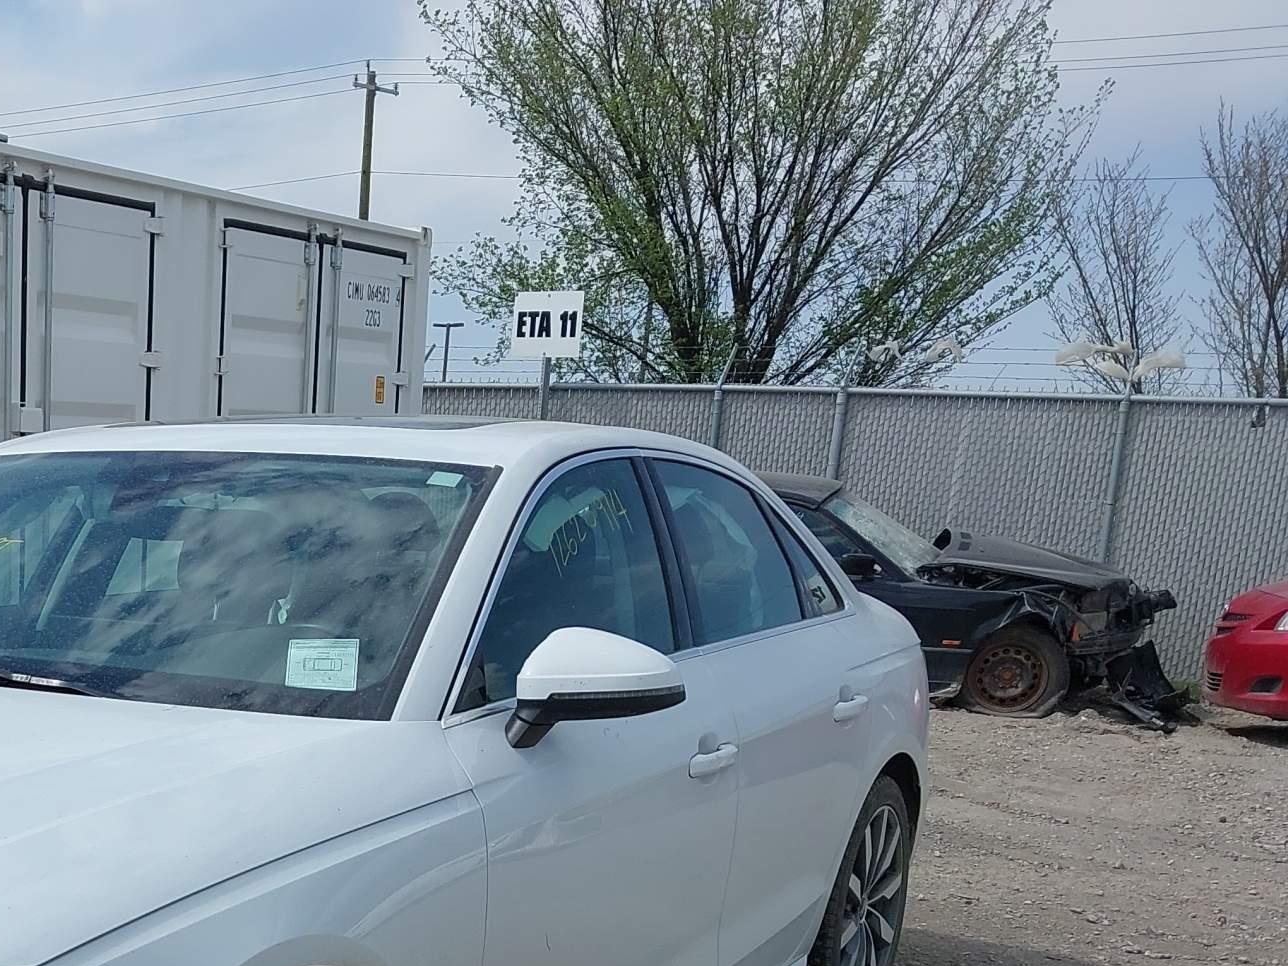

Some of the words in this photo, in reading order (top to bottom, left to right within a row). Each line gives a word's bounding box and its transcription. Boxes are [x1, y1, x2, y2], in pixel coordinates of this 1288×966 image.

[347, 281, 364, 301] CIMU
[516, 310, 552, 338] ETA
[559, 310, 578, 338] 11
